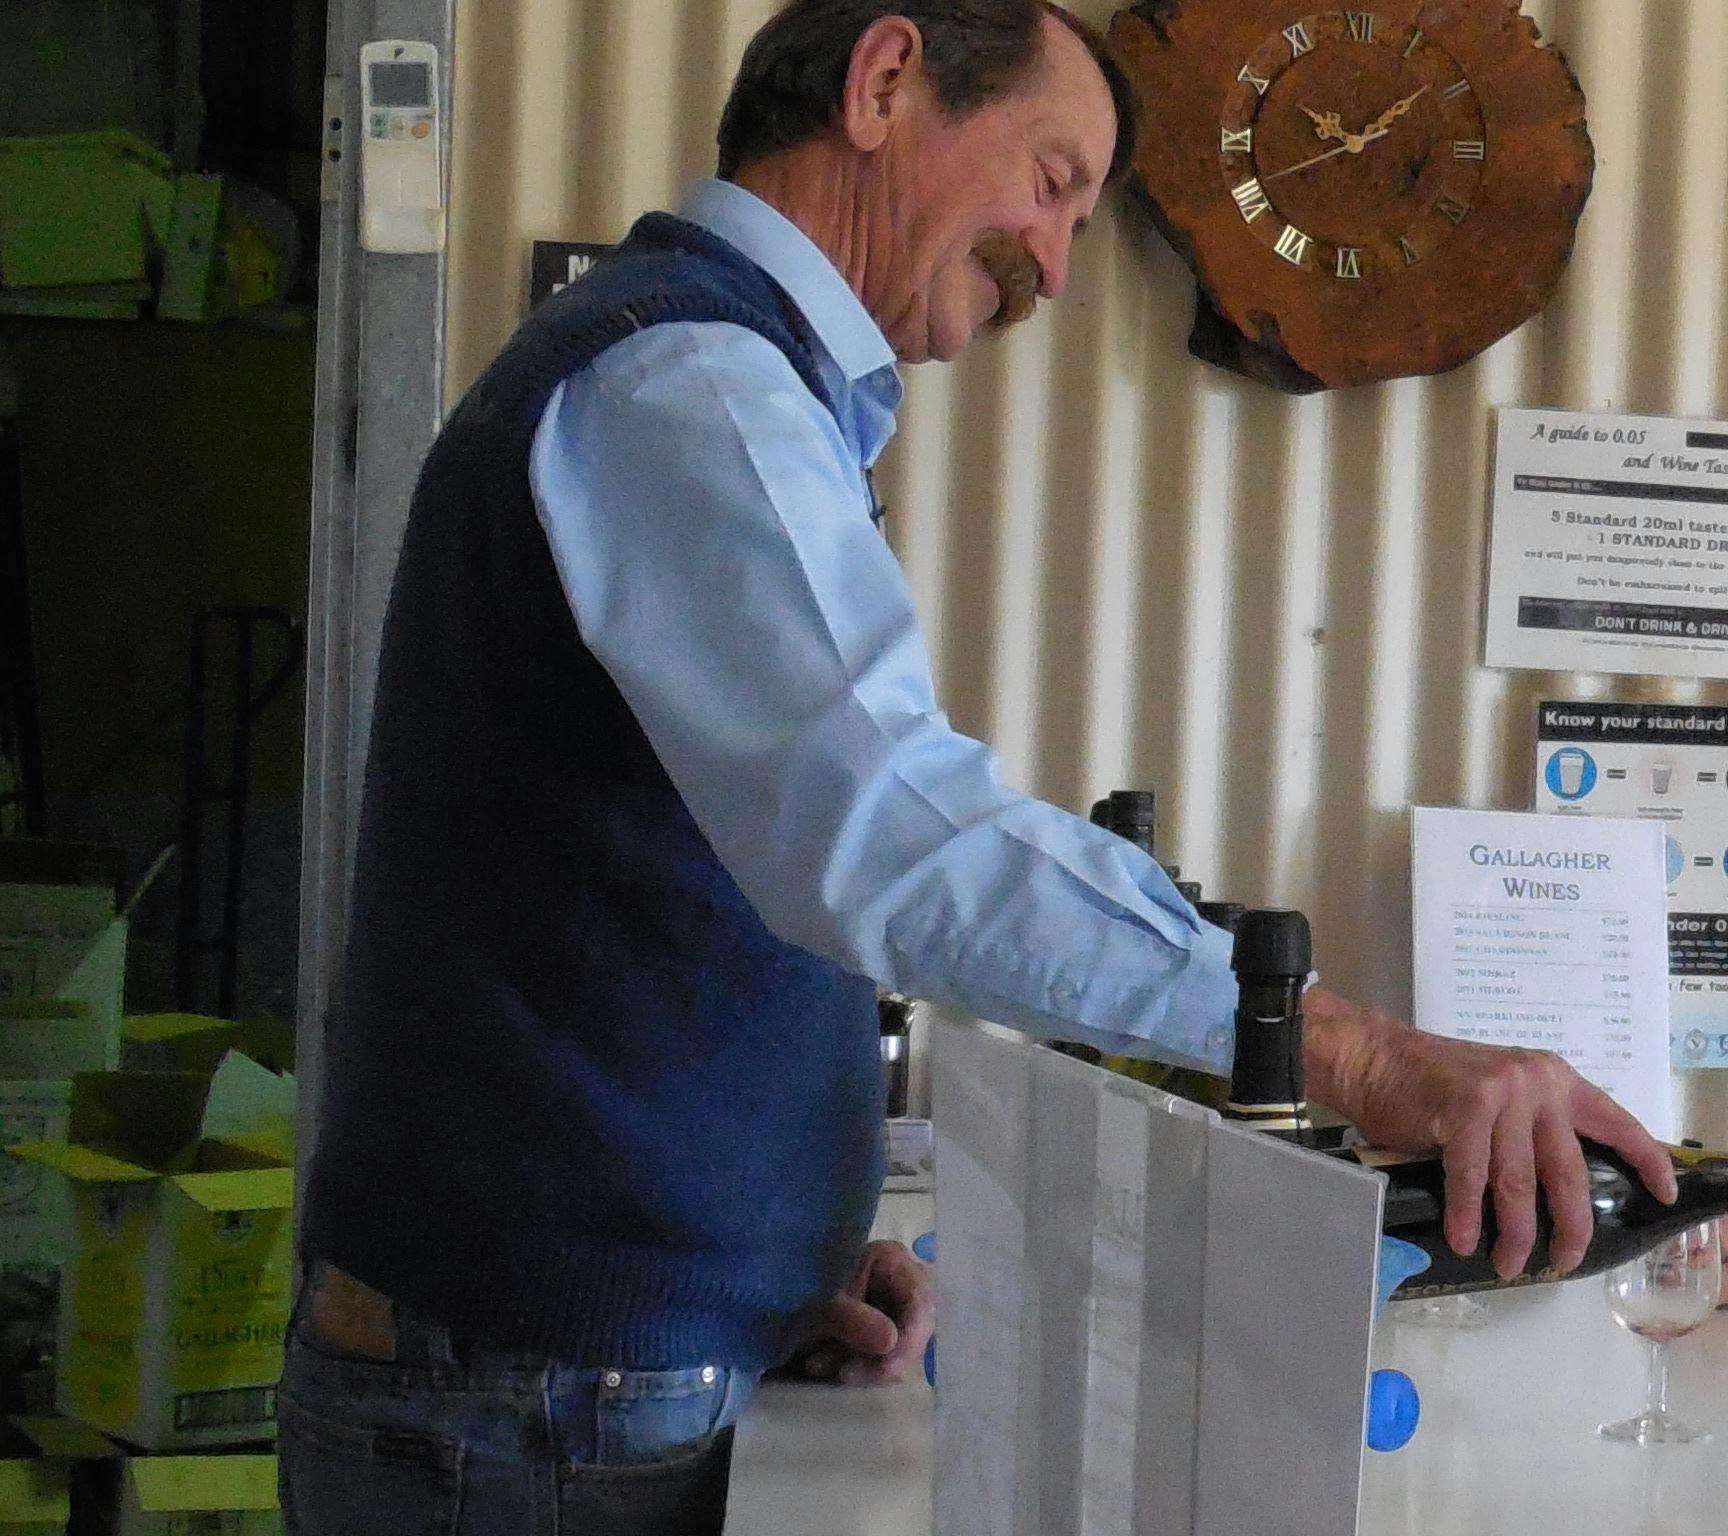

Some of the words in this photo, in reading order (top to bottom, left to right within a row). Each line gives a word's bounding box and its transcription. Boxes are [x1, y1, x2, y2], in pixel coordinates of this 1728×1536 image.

[1530, 423, 1546, 440] A
[1548, 425, 1589, 444] guide
[1594, 430, 1609, 443] to
[1612, 429, 1647, 445] 0.05
[1621, 453, 1651, 469] and
[1659, 455, 1700, 473] Wine
[1565, 511, 1638, 530] Standard
[1642, 517, 1685, 533] 20ml
[1597, 533, 1606, 546] 1
[1612, 533, 1701, 551] STANDARD
[1594, 615, 1638, 630] DON'T
[1639, 617, 1683, 633] DRINK
[1685, 621, 1698, 635] &
[1545, 710, 1596, 727] Know
[1600, 715, 1642, 732] your
[1646, 715, 1726, 732] standard
[1469, 843, 1612, 871] GALLAGHER
[1502, 877, 1581, 901] WINES
[1667, 919, 1709, 933] nder
[1679, 978, 1704, 993] few
